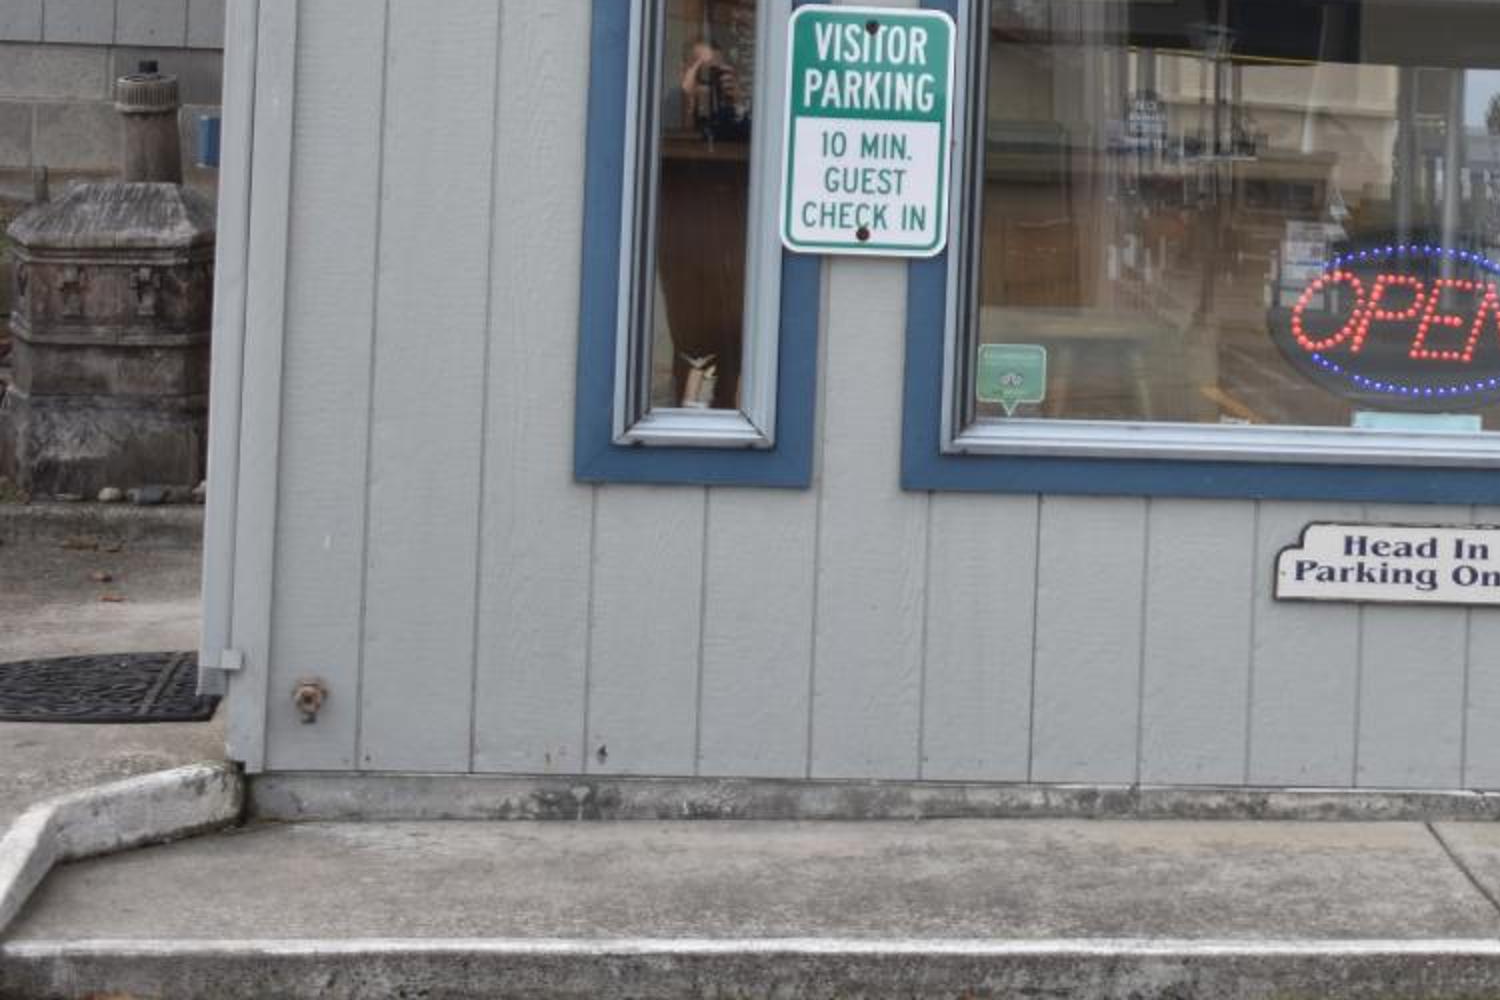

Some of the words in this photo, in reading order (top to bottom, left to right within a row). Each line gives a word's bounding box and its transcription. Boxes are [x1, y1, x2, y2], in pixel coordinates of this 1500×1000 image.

[814, 22, 928, 65] VISITOR
[803, 69, 936, 112] PARKING
[822, 131, 847, 157] 10
[860, 132, 913, 161] MIN.
[824, 166, 907, 196] GUEST
[801, 201, 888, 230] CHECK
[901, 204, 928, 231] IN
[1343, 535, 1438, 559] Head
[1454, 538, 1490, 560] In
[1294, 560, 1439, 591] Parking
